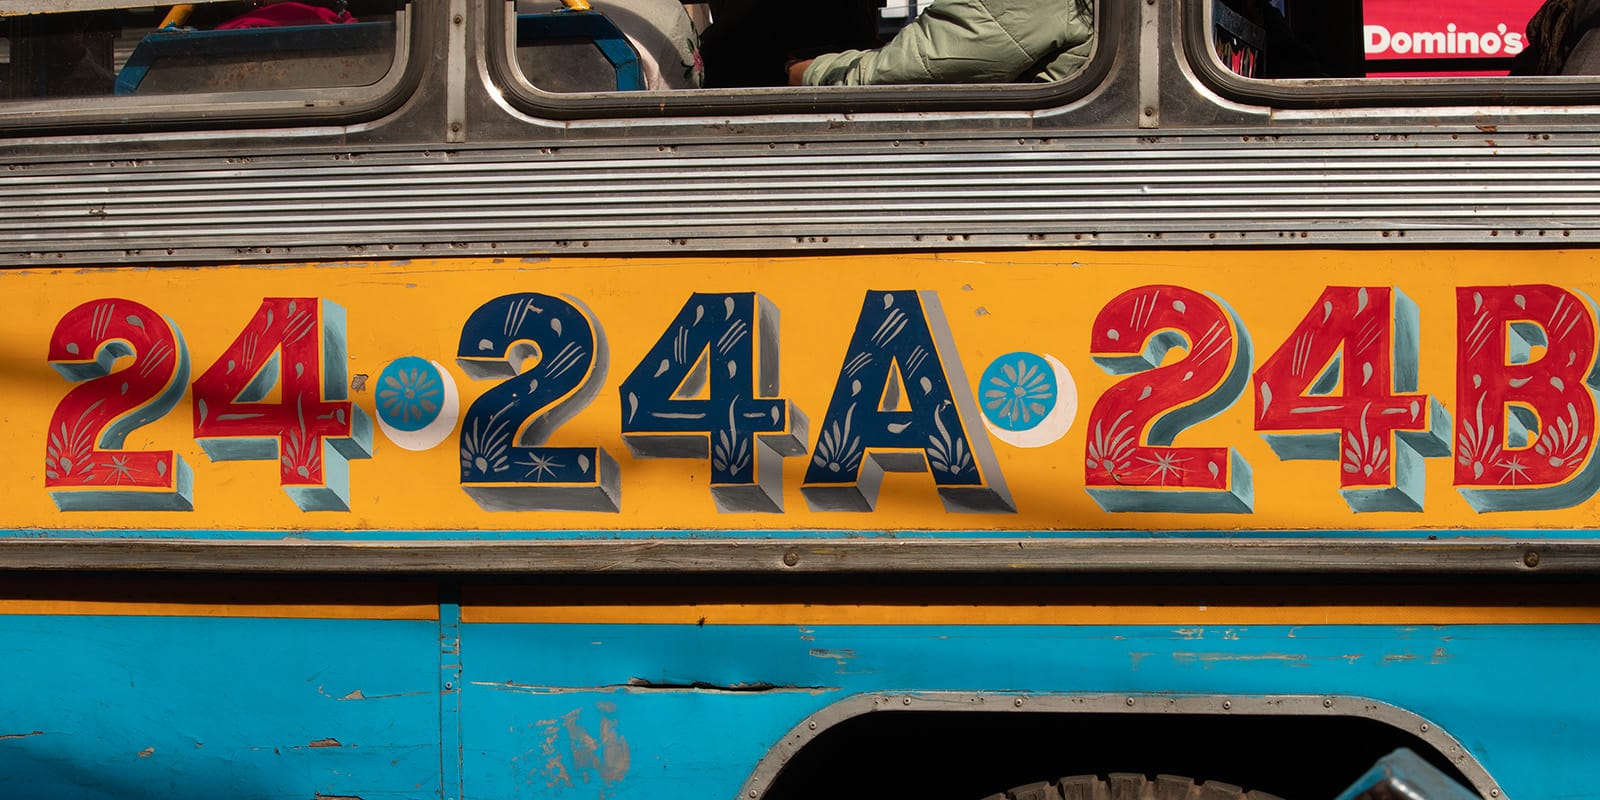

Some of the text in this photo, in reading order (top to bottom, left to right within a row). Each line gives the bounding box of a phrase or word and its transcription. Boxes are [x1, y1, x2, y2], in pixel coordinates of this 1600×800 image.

[1363, 23, 1523, 54] Domino's
[45, 284, 1600, 513] 24 24A 24B
